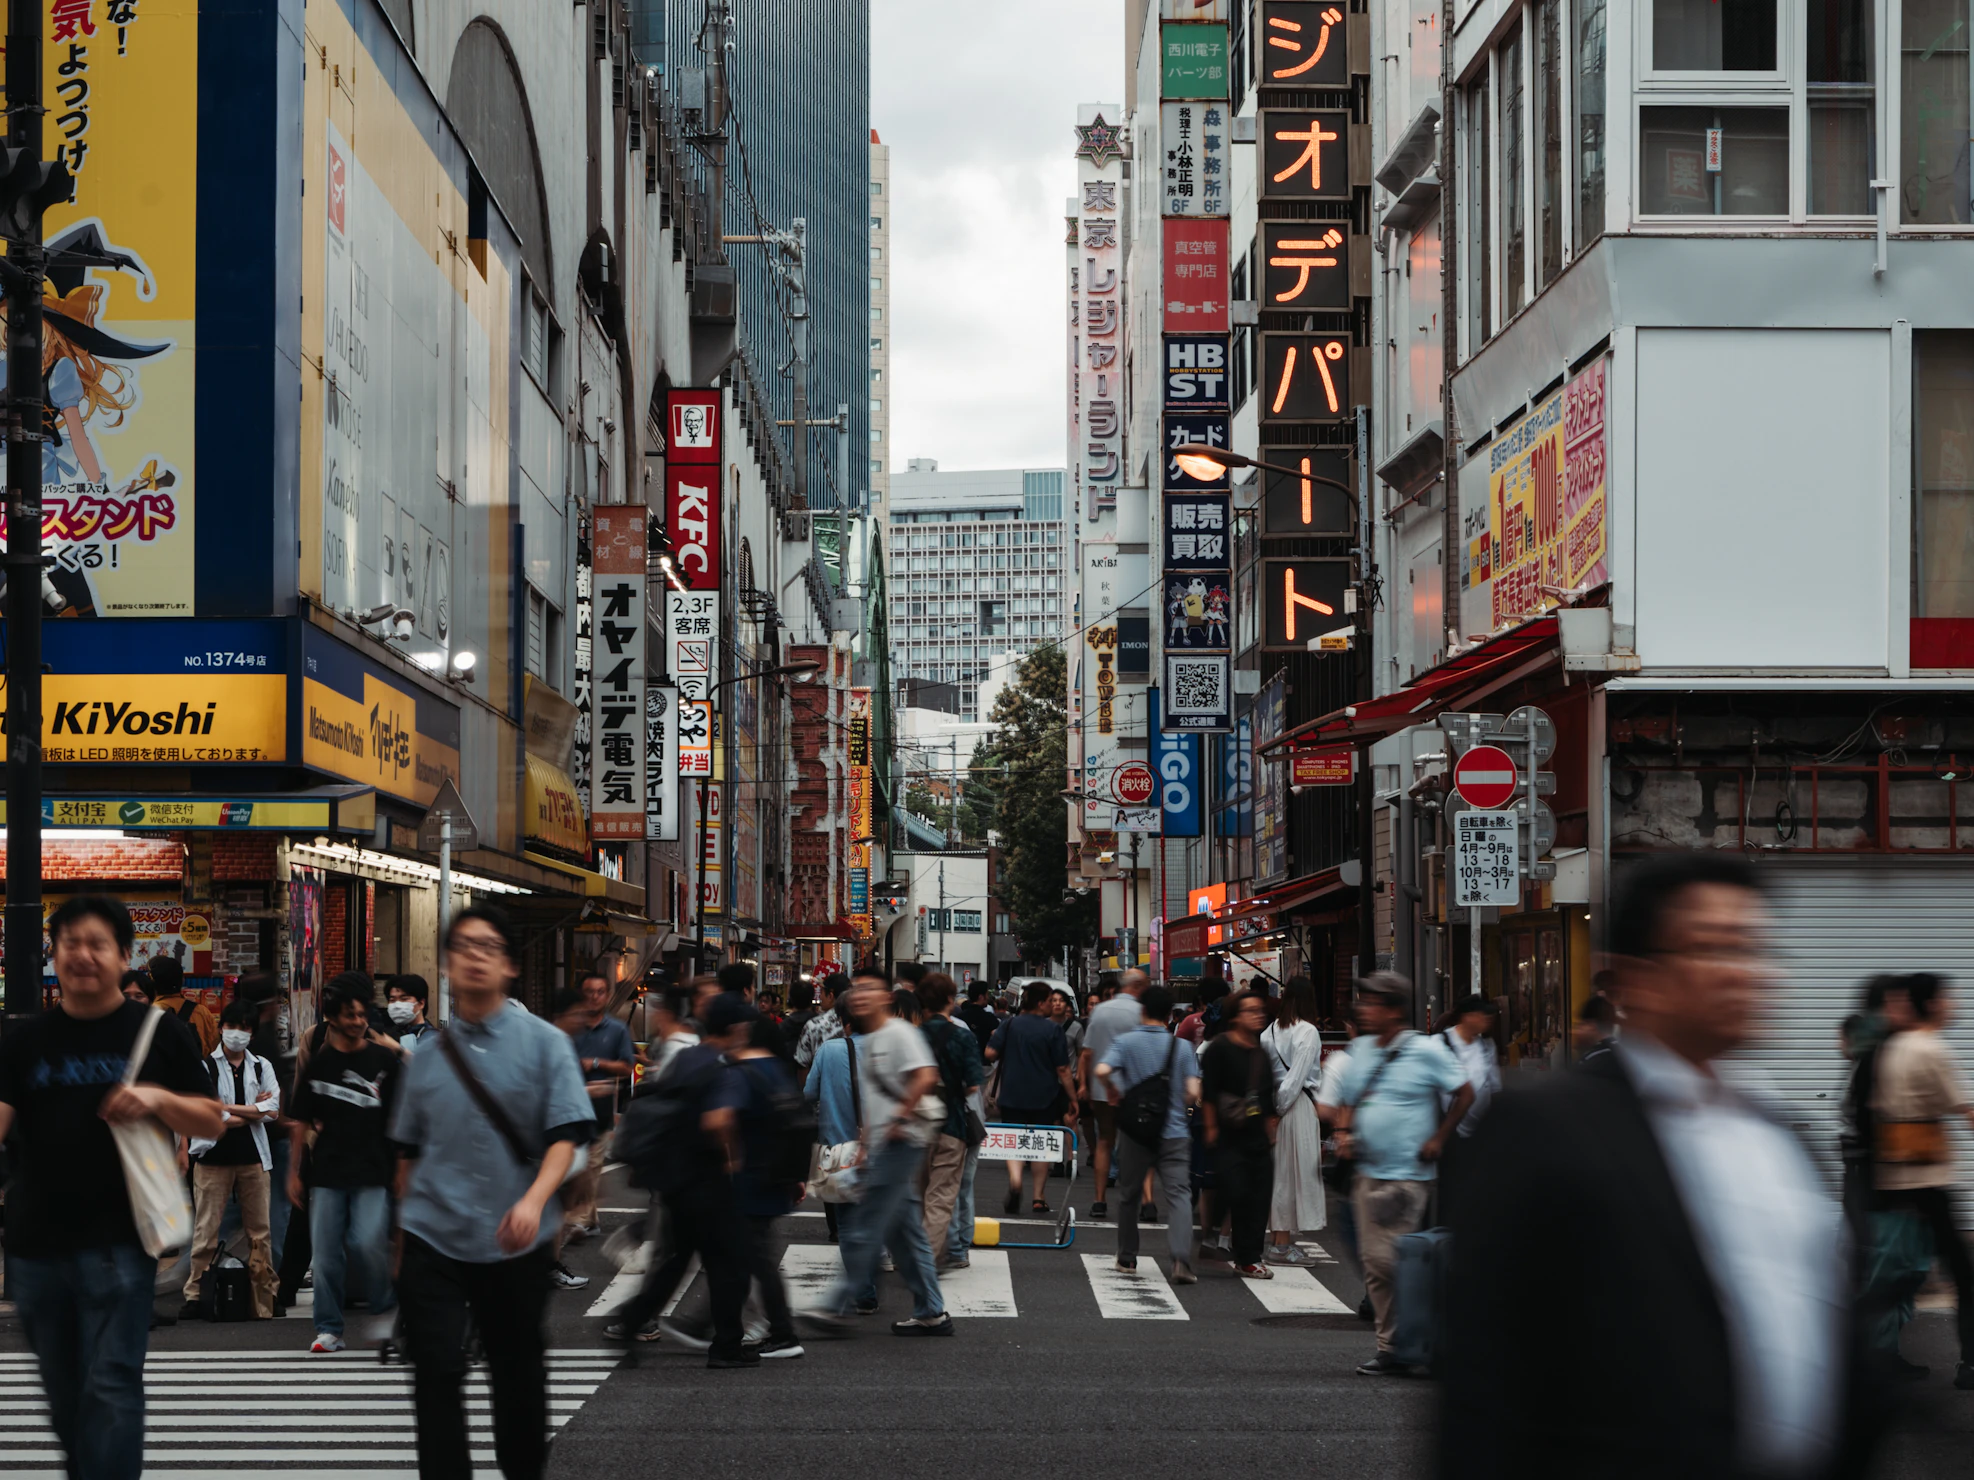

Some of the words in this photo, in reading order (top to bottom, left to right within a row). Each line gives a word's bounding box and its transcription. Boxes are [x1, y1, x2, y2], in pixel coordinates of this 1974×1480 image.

[1168, 43, 1222, 57] 西川電子
[1168, 66, 1222, 79] パーツ部
[1203, 108, 1222, 197] 森事務所
[1167, 150, 1177, 196] 事務所
[1171, 199, 1190, 214] 6F
[1204, 200, 1222, 214] 6F
[1175, 241, 1217, 255] 真空管
[1175, 264, 1217, 278] 専門店
[1268, 7, 1344, 641] ジオデパート
[1083, 180, 1118, 523] 東京レジャーランド
[1169, 344, 1224, 368] HB
[1169, 374, 1224, 398] ST
[1565, 371, 1605, 437] ギフトカード
[41, 482, 104, 494] パックご購入で
[327, 456, 360, 522] Kanebo
[678, 481, 709, 573] KFC
[1171, 504, 1225, 530] 販売
[42, 543, 118, 569] くる！
[1171, 534, 1224, 560] 買取
[672, 597, 714, 615] 2,3F
[675, 617, 711, 636] 客席
[1121, 641, 1149, 650] IMON
[600, 583, 638, 805] オヤイデ電気
[1098, 653, 1115, 735] TOWER
[51, 702, 217, 735] KiYoshi
[679, 753, 709, 771] 弁当
[1159, 732, 1191, 814] iGO
[1121, 777, 1151, 792] 消火栓
[58, 802, 106, 817] 支付宝
[150, 803, 194, 815] 微信支付
[593, 821, 642, 833] 通信販売
[1460, 817, 1513, 828] 自転車を除く
